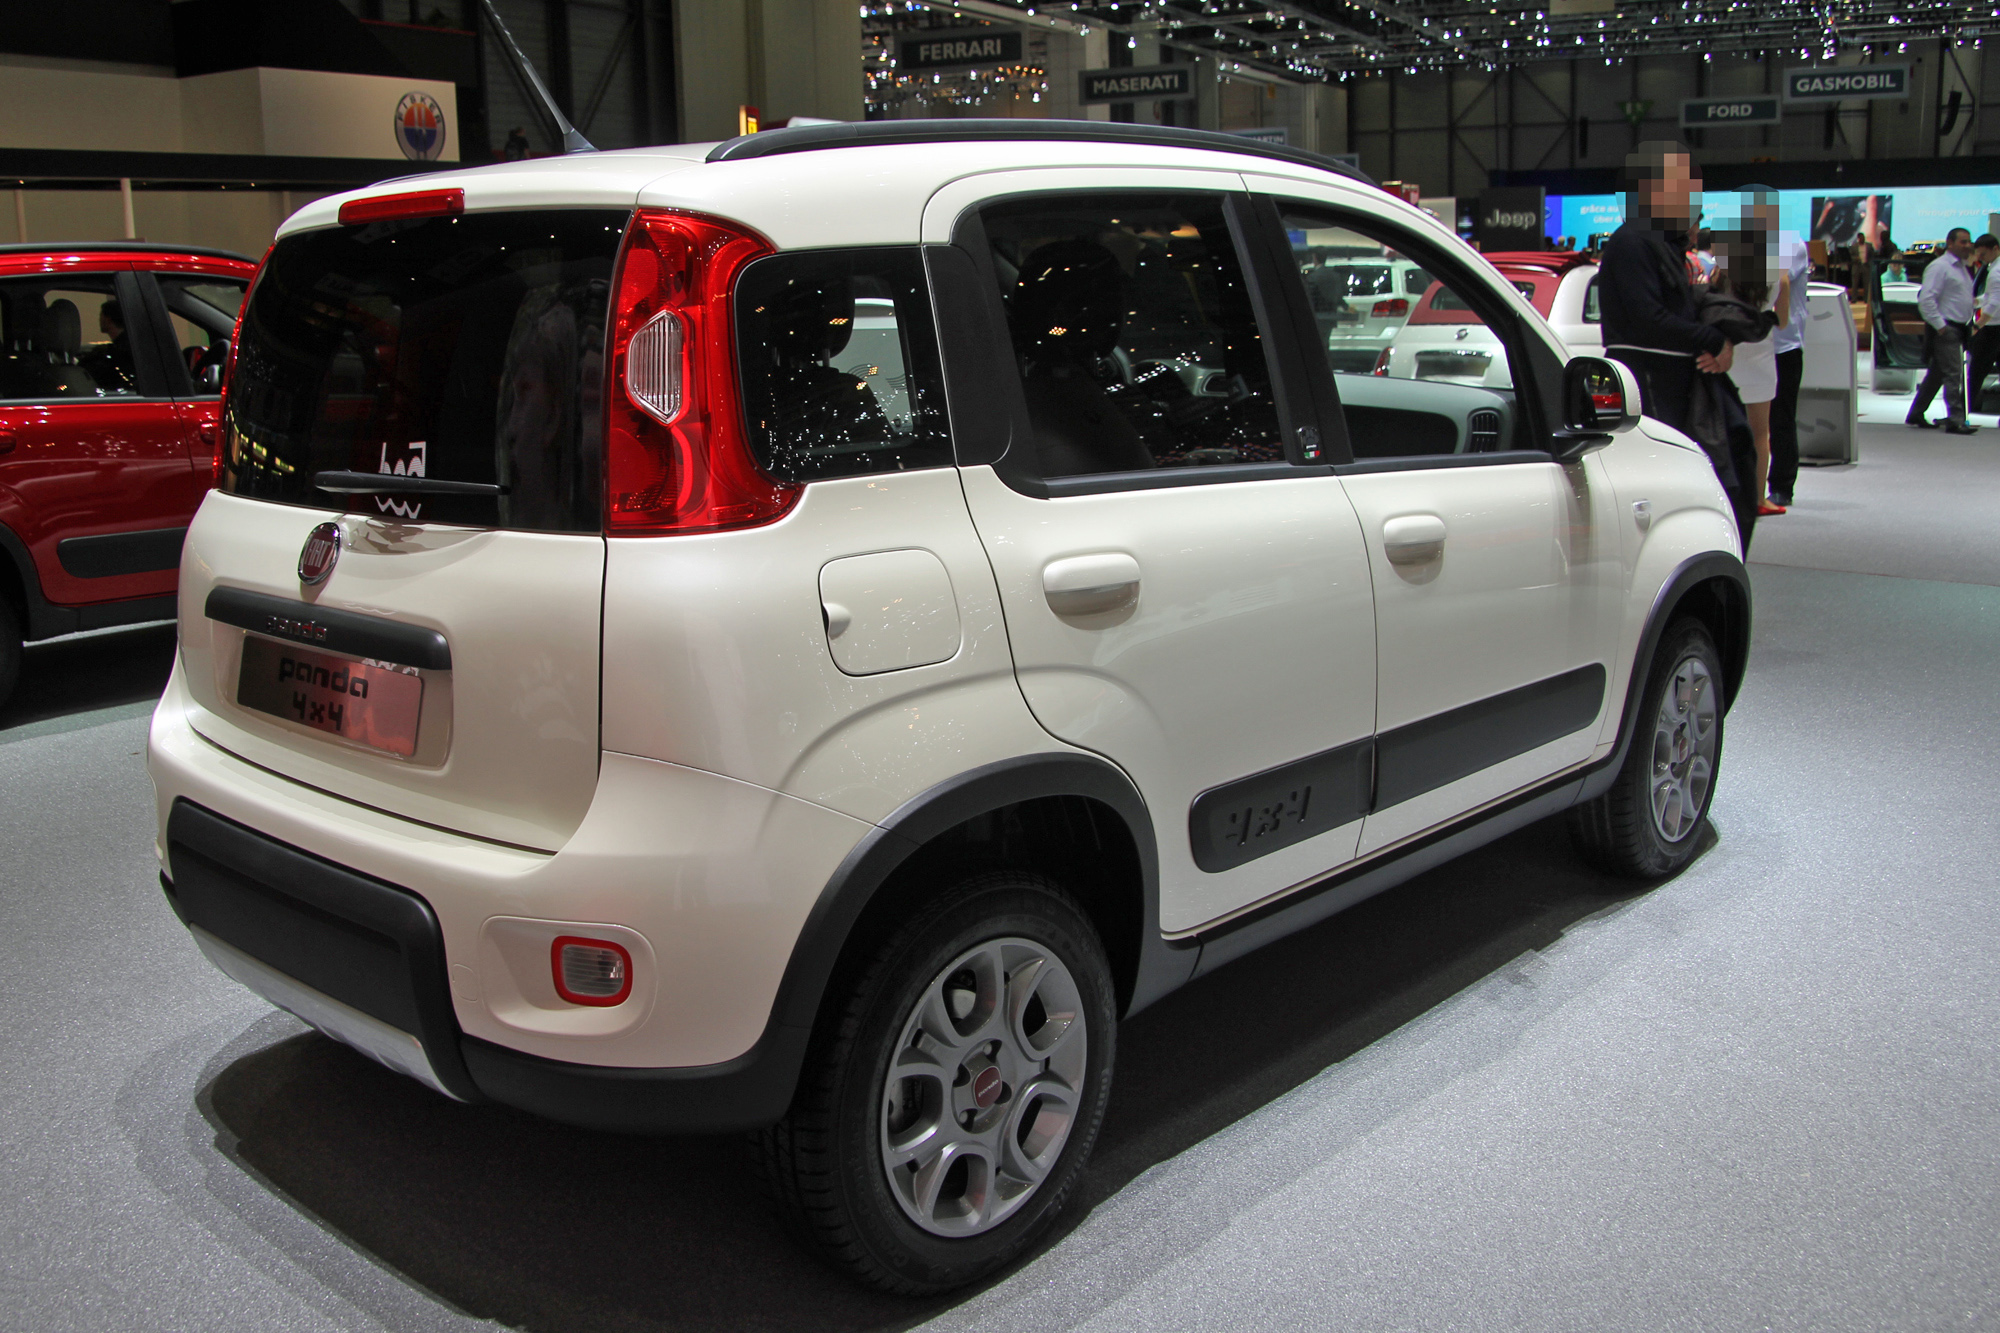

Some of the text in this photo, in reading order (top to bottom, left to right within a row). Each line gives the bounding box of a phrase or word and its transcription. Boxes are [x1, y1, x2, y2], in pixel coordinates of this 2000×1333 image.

[919, 38, 1001, 62] FERRARI
[1093, 73, 1180, 95] MASERATI
[1796, 73, 1897, 93] GASMOBIL
[398, 94, 442, 124] FISKER
[1707, 103, 1753, 119] FORD
[1484, 208, 1537, 230] Jeep
[302, 537, 332, 568] FIAT
[265, 614, 328, 641] panda
[278, 656, 370, 700] panda
[292, 690, 344, 732] 4x4
[1224, 785, 1312, 848] 4x4
